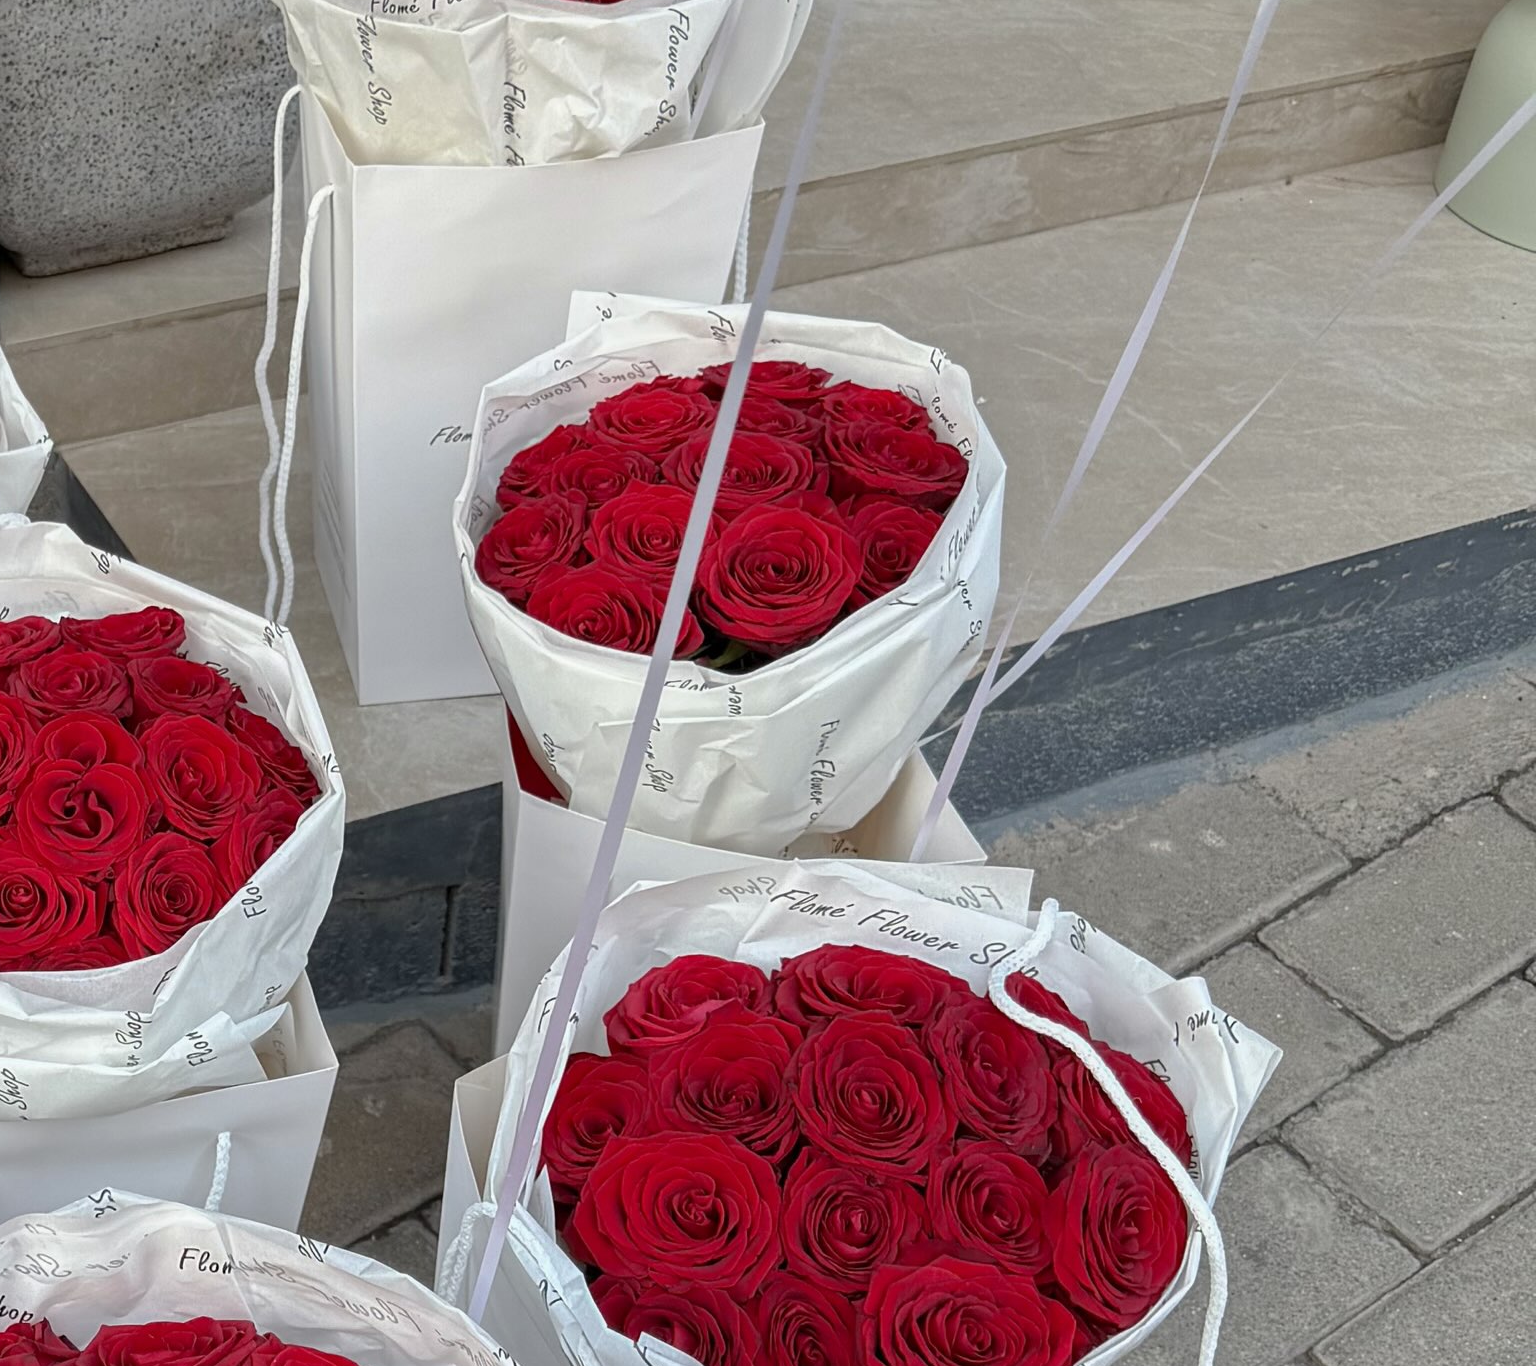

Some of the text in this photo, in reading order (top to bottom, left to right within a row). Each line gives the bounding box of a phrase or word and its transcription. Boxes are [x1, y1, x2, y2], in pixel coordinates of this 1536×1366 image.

[662, 7, 689, 92] Flower
[366, 81, 393, 126] Shop
[503, 80, 527, 139] Flomé
[430, 425, 473, 446] Flom
[770, 888, 855, 919] Flomé
[858, 908, 961, 952] Flower
[115, 1009, 153, 1050] Shop
